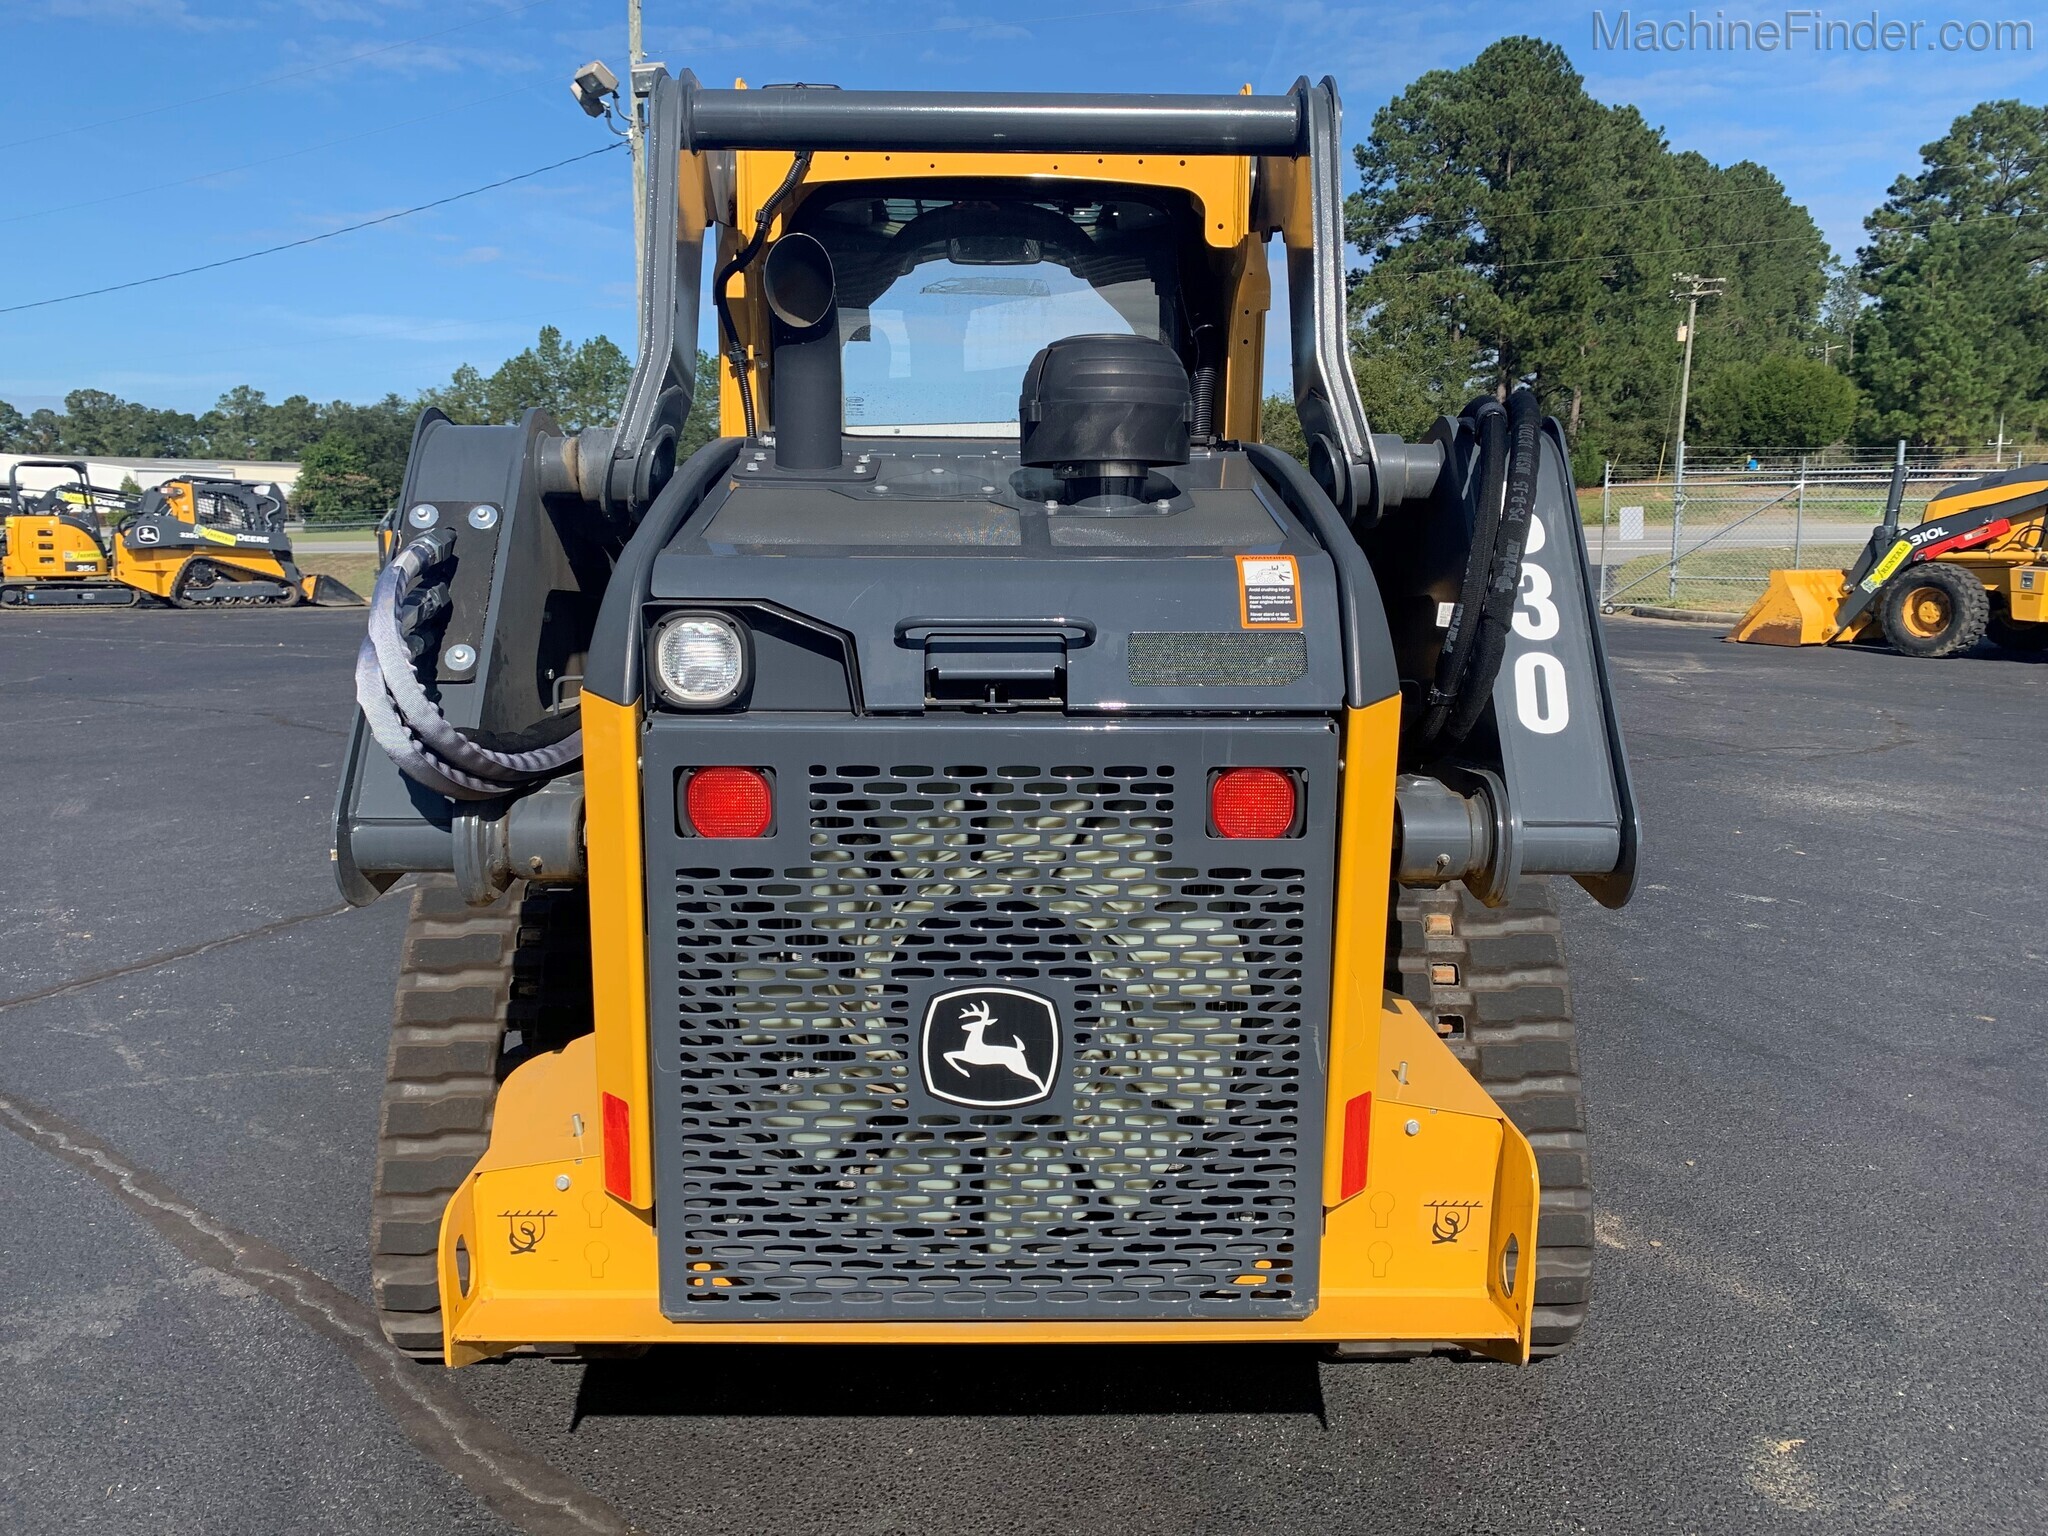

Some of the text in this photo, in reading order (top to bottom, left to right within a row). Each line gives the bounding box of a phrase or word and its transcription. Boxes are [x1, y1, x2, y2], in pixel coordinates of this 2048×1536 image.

[96, 497, 126, 508] DEERE
[237, 534, 269, 543] DEERE
[1495, 539, 1520, 593] Parker
[1508, 481, 1529, 522] PS-B-15
[1910, 527, 1949, 546] 310L
[1882, 543, 1909, 574] RENTALS
[77, 564, 96, 572] 35G
